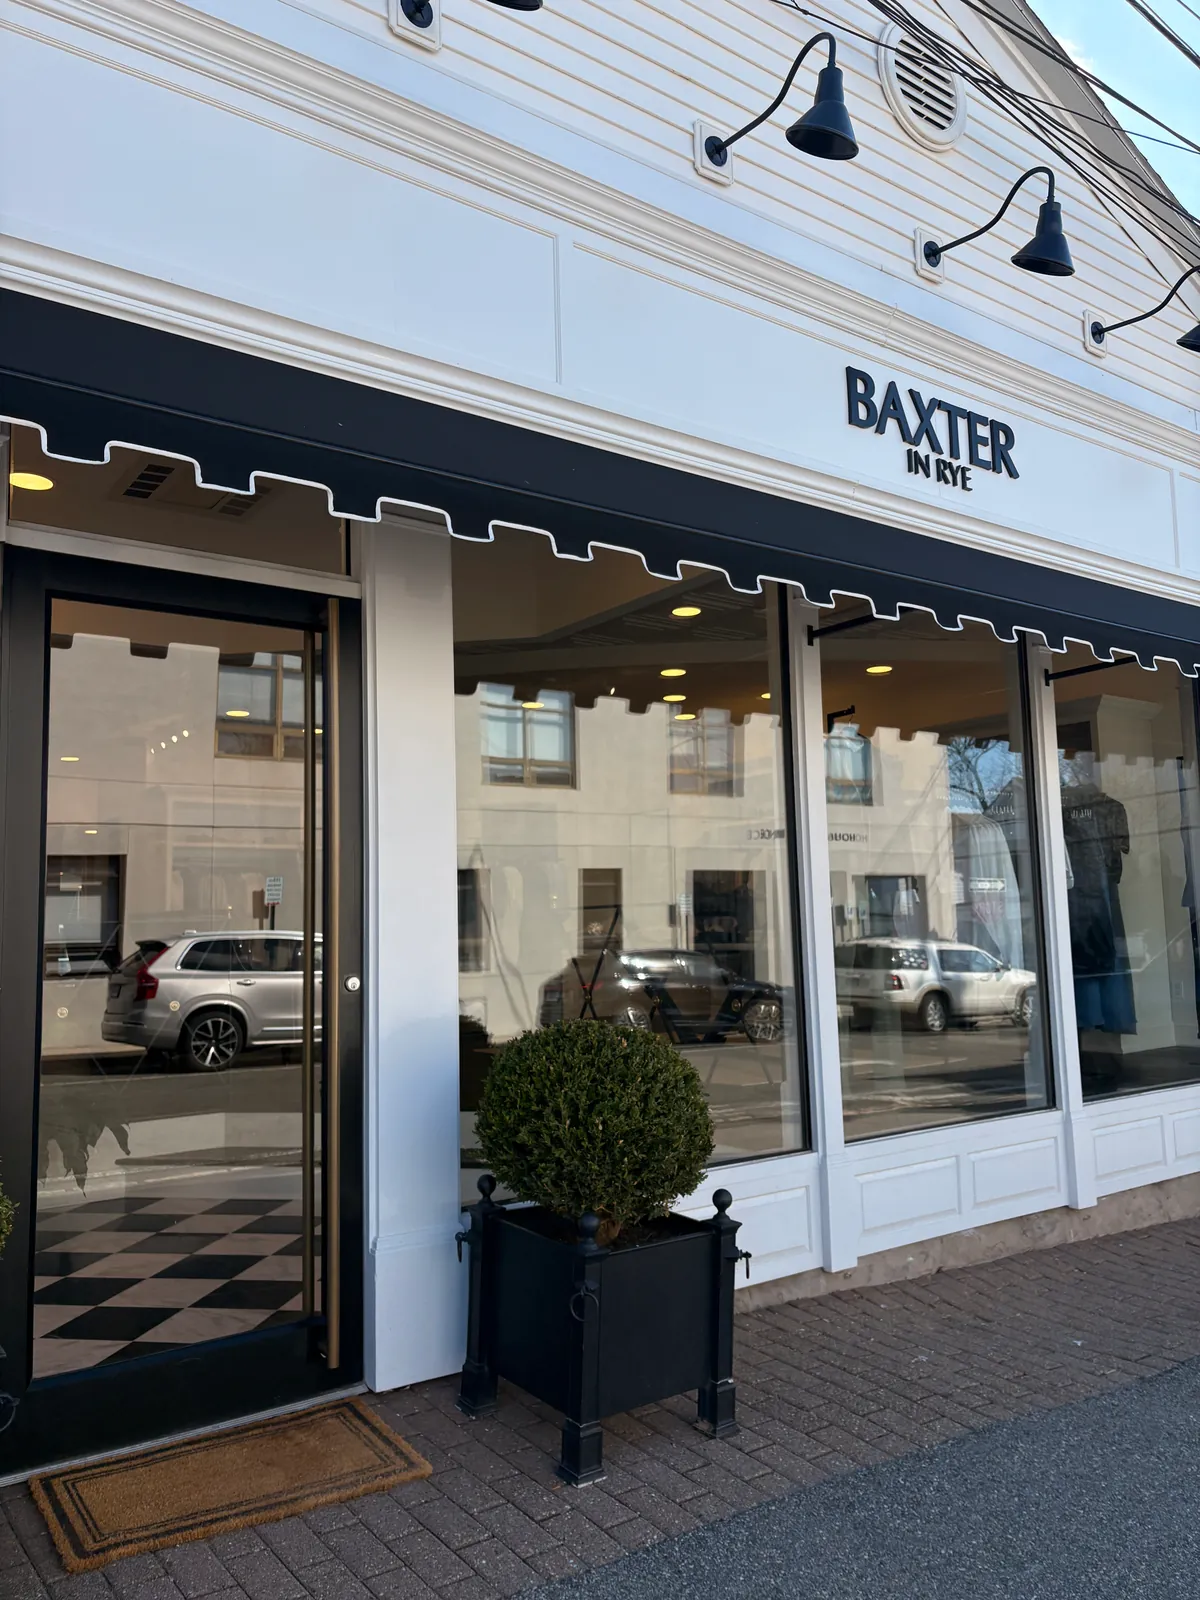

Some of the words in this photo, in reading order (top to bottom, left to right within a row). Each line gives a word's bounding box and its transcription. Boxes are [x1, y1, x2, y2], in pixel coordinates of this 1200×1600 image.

[845, 365, 1020, 480] BAXTER
[906, 448, 931, 479] IN
[935, 457, 973, 492] RYE
